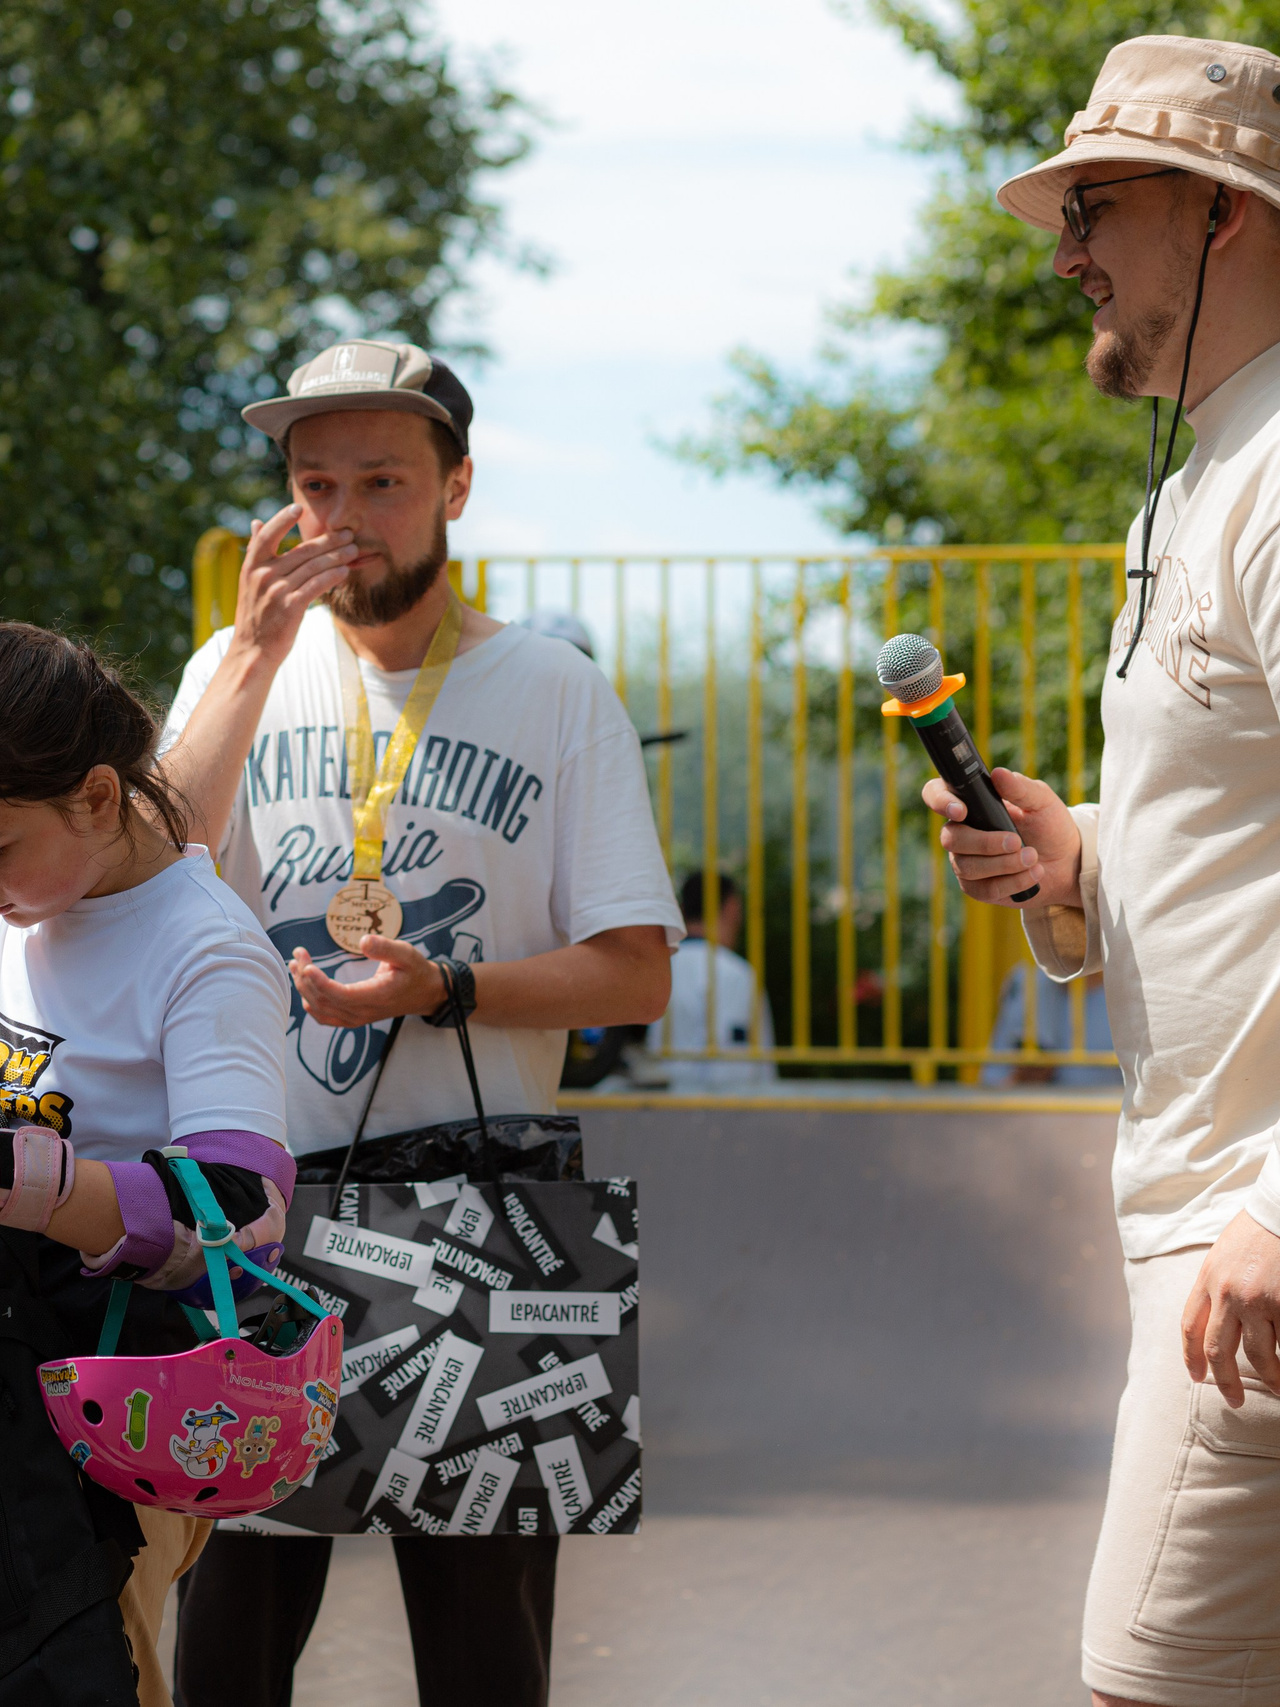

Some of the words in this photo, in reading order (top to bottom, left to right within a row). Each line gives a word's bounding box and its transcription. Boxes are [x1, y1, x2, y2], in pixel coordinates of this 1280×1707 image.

[261, 821, 444, 912] Rusia
[360, 883, 369, 900] 1
[47, 1381, 70, 1395] SNOW
